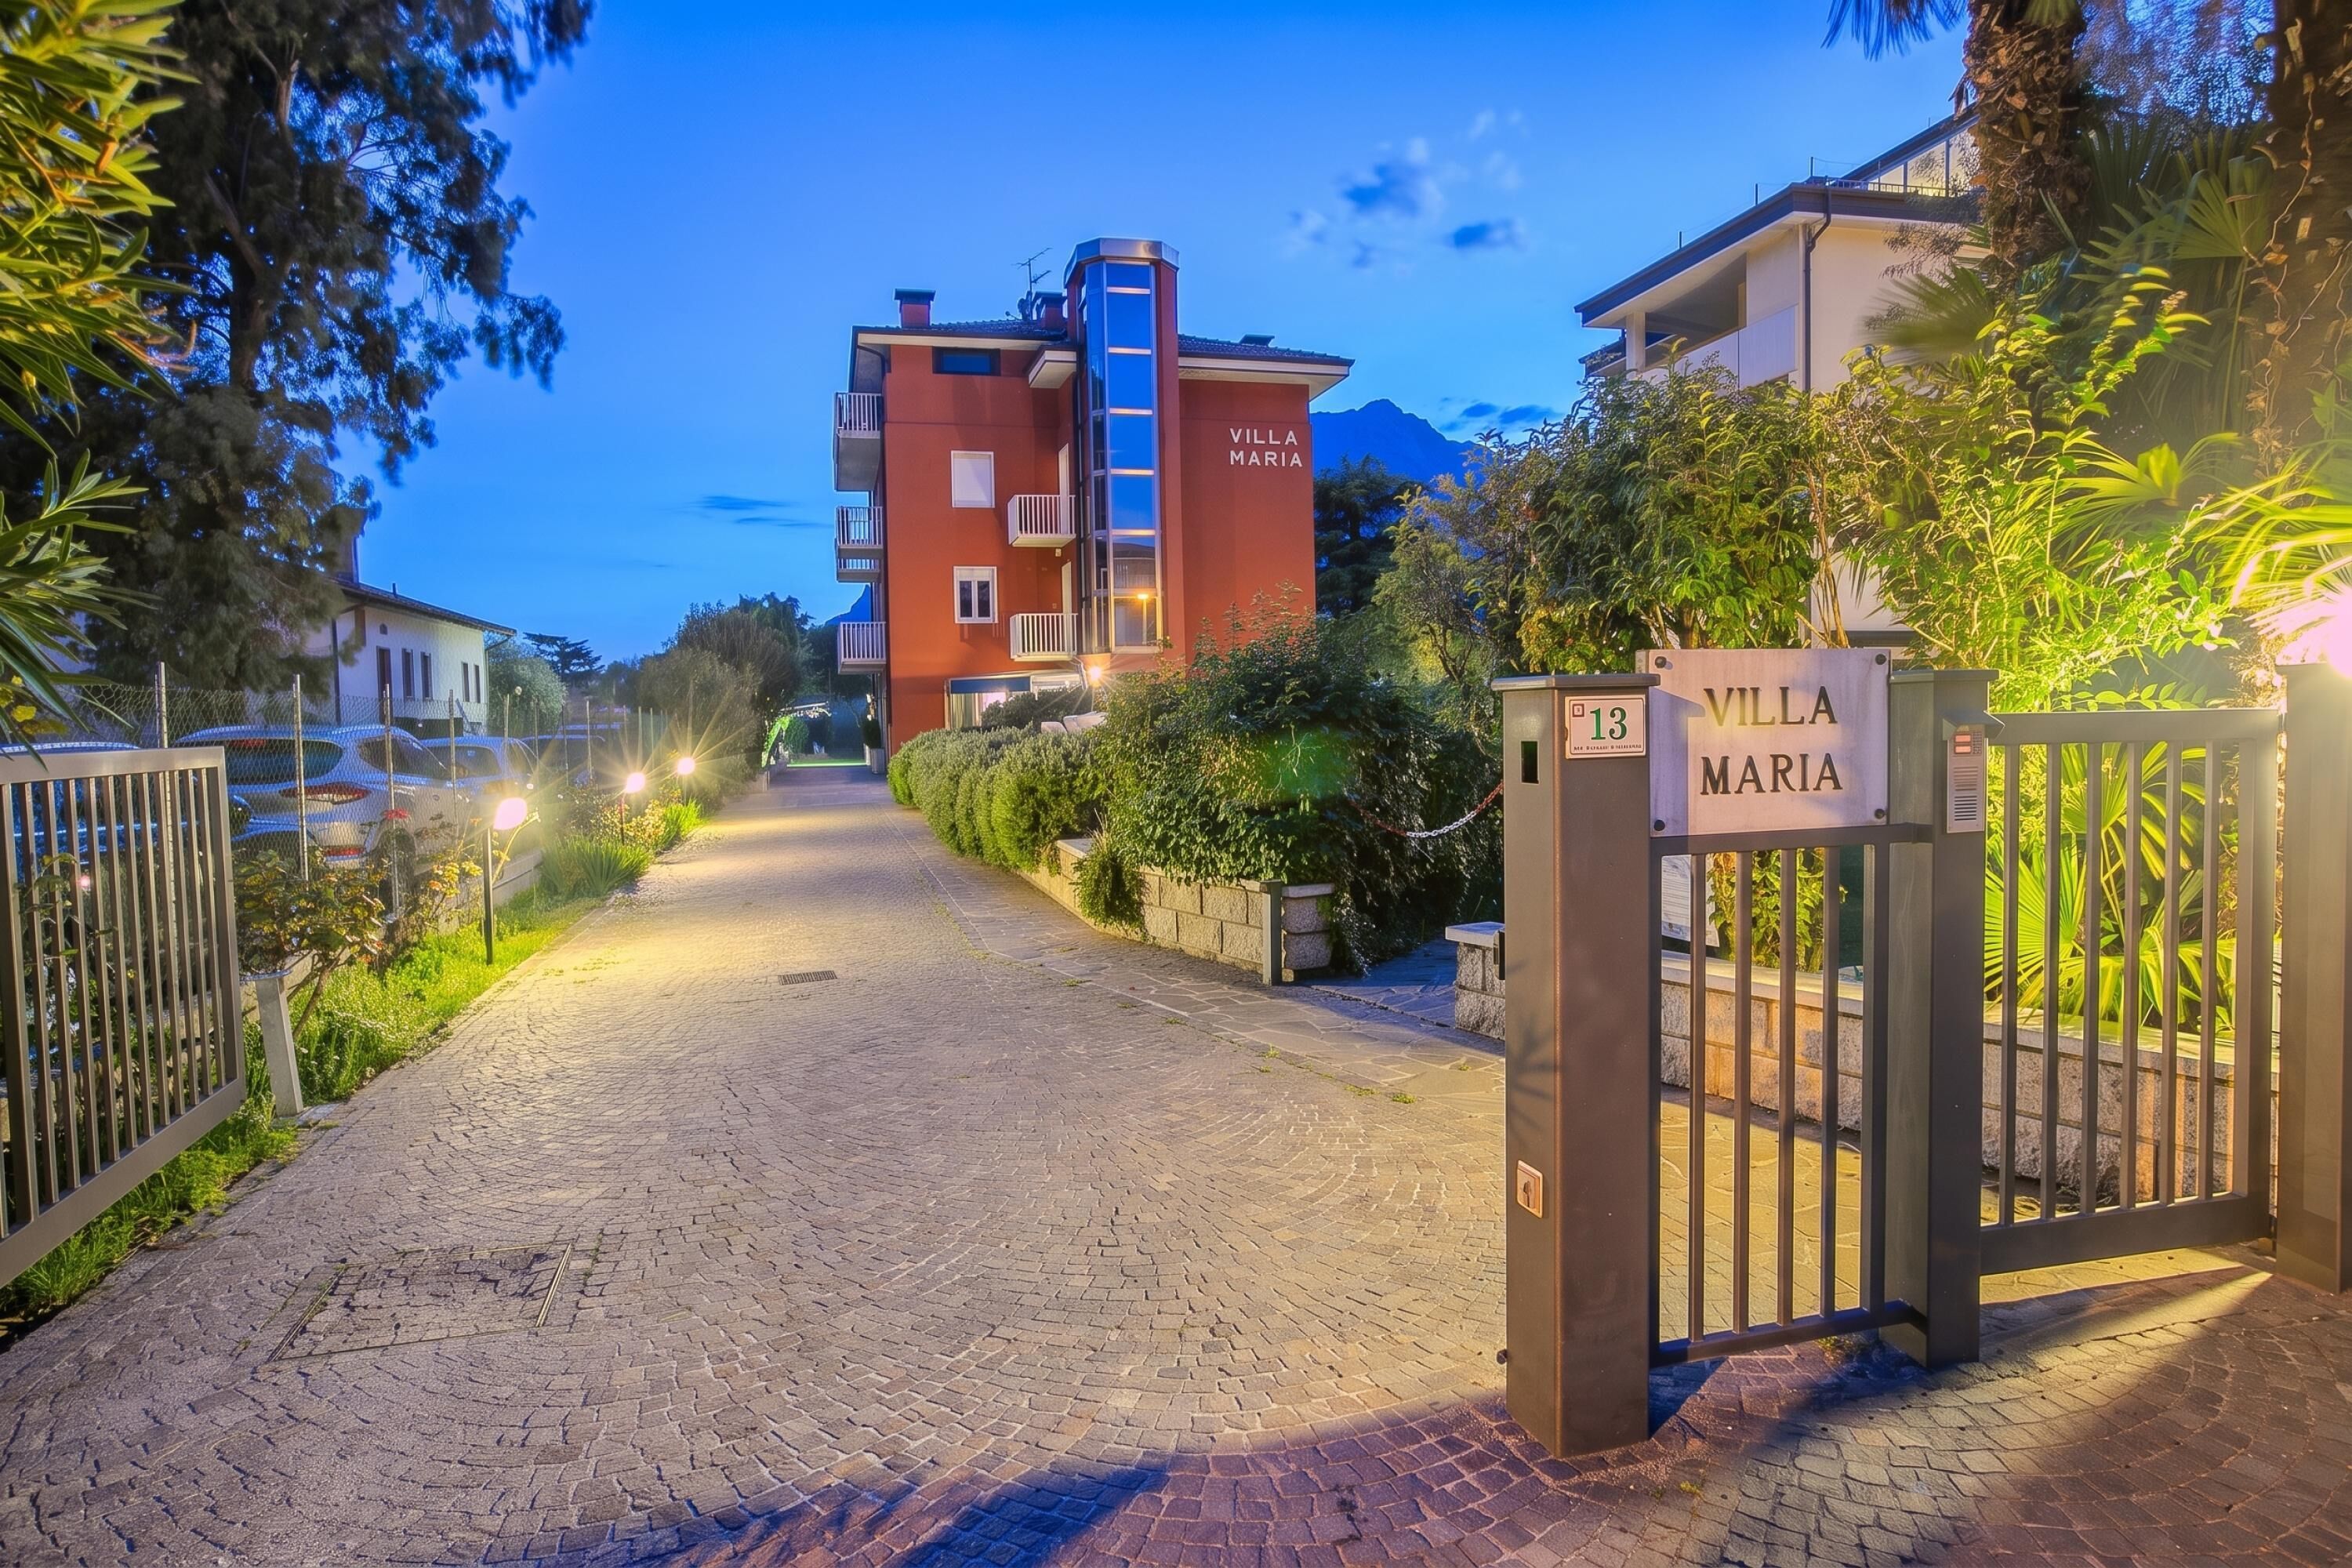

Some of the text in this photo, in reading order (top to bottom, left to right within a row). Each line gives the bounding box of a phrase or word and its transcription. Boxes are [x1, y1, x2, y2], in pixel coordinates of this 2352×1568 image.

[1229, 428, 1298, 445] VILLA
[1229, 450, 1302, 467] MARIA
[1589, 706, 1628, 740] 13
[1703, 685, 1838, 727] VILLA
[1700, 753, 1843, 796] MARIA
